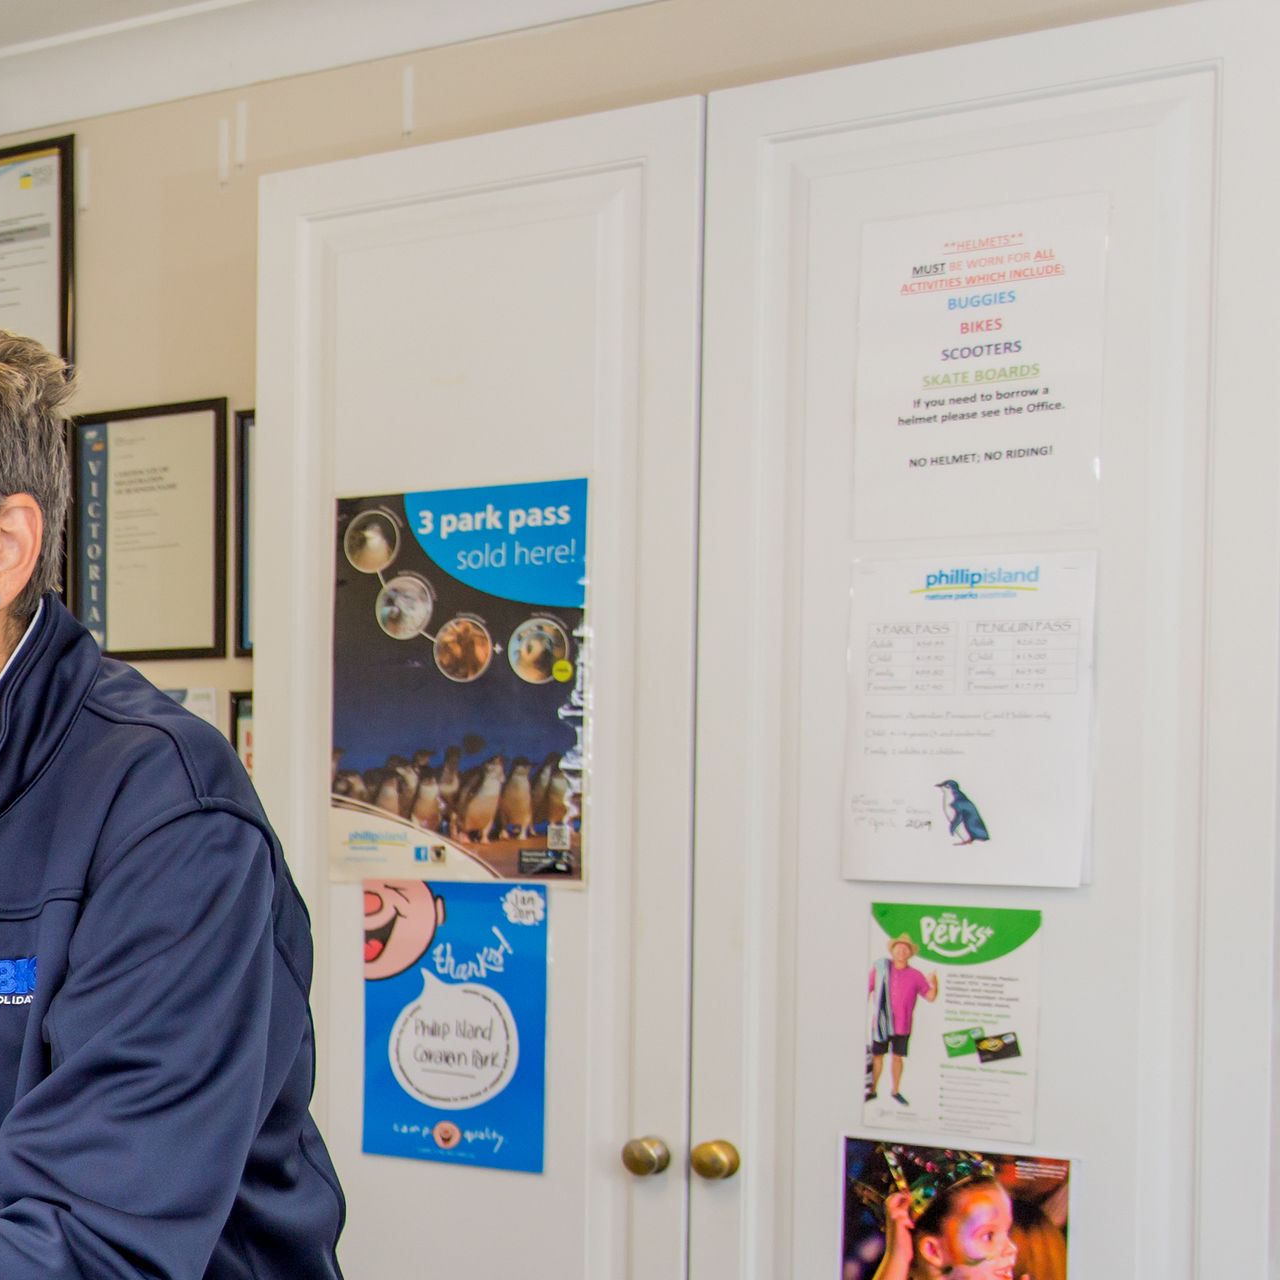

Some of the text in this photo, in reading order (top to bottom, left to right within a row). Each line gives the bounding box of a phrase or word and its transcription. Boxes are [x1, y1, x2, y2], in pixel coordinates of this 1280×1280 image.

[912, 249, 1055, 277] MUST BE WORN FOR ALL
[900, 277, 961, 294] ACTIVITIES
[965, 272, 1006, 286] WHICH
[947, 290, 1017, 310] BUGGIES
[960, 318, 1003, 334] BIKES
[940, 340, 1023, 361] SCOOTERS
[922, 363, 1041, 388] SKATE BOARDS
[913, 387, 1049, 410] If you need to borrow a
[897, 401, 1066, 427] helmet please see the Office.
[908, 457, 927, 469] NO
[984, 451, 1003, 463] NO
[1005, 445, 1053, 460] RIDING!
[418, 510, 435, 535] 3
[440, 505, 501, 541] park
[508, 503, 572, 537] pass
[456, 538, 576, 570] sold here!
[954, 591, 979, 602] parks
[393, 1121, 430, 1137] camp
